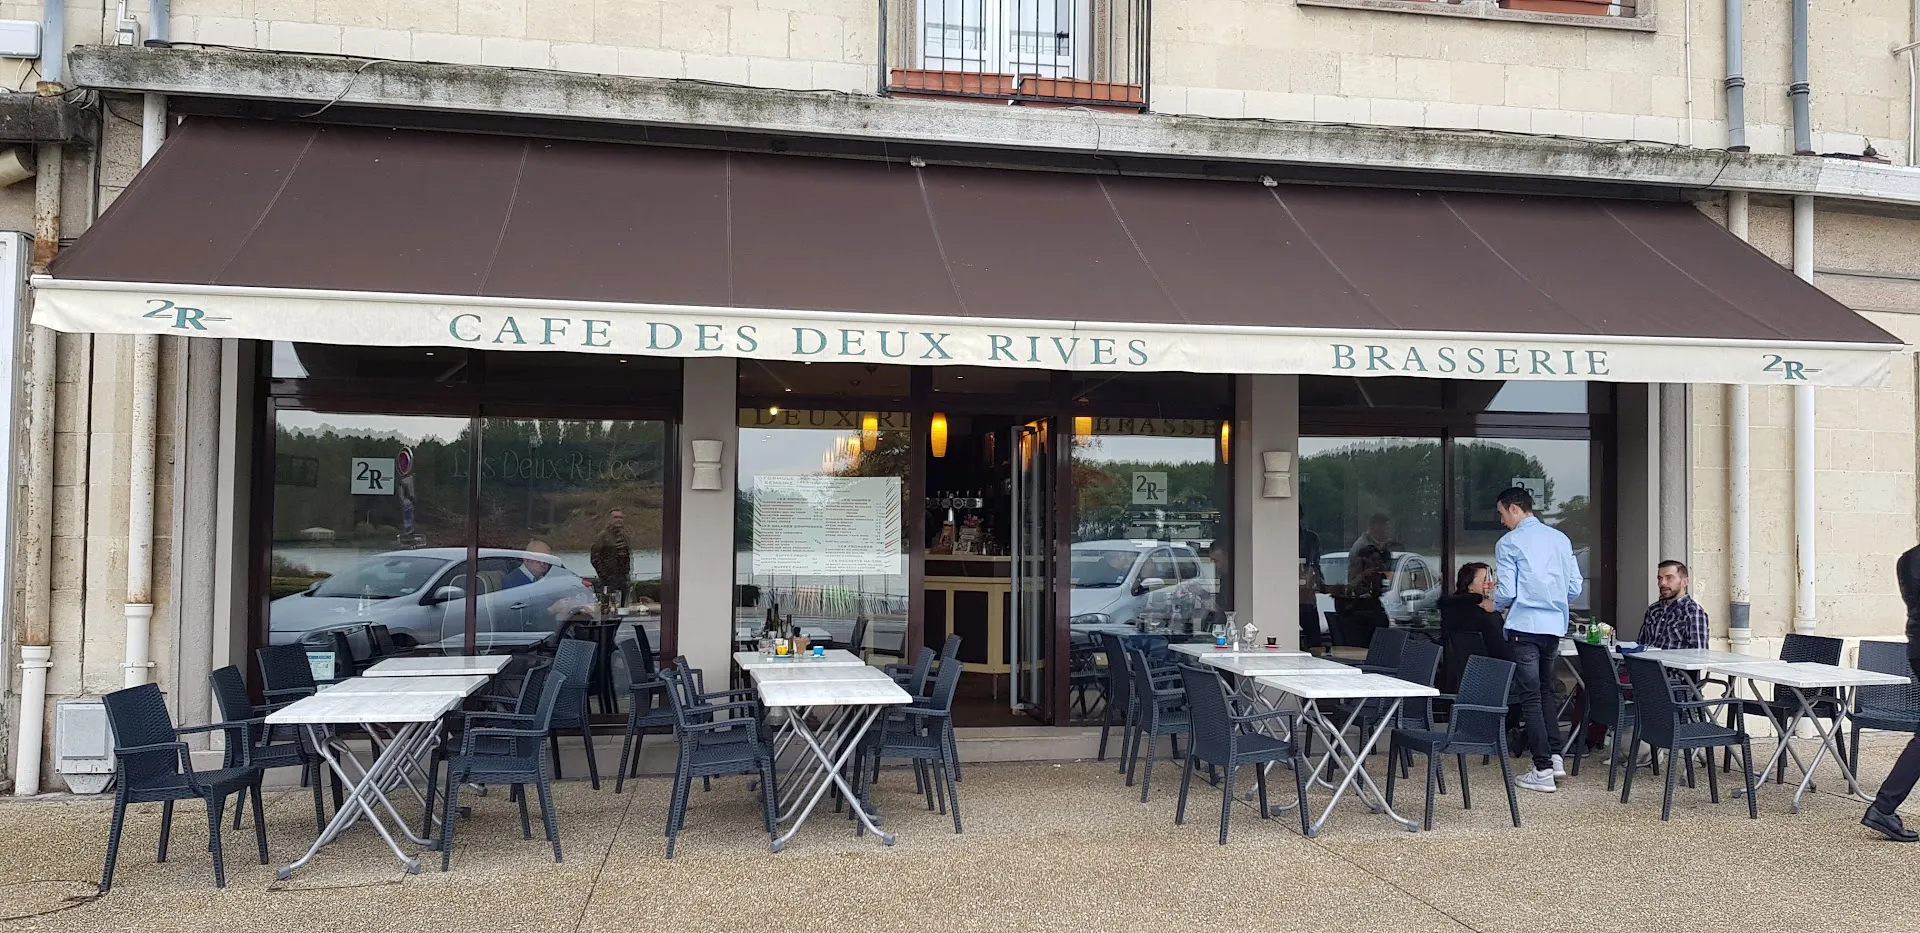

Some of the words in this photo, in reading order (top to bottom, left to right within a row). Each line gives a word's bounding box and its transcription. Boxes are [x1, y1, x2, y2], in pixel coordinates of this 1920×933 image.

[143, 299, 208, 331] 2R
[449, 313, 612, 347] CAFE
[647, 321, 758, 353] DES
[791, 326, 953, 360] DEUX
[986, 334, 1152, 368] RIVES
[1331, 343, 1611, 376] BRASSERIE
[1763, 354, 1808, 380] 2R
[356, 461, 384, 490] 2R
[452, 449, 497, 478] Ls
[1136, 474, 1160, 500] 2R
